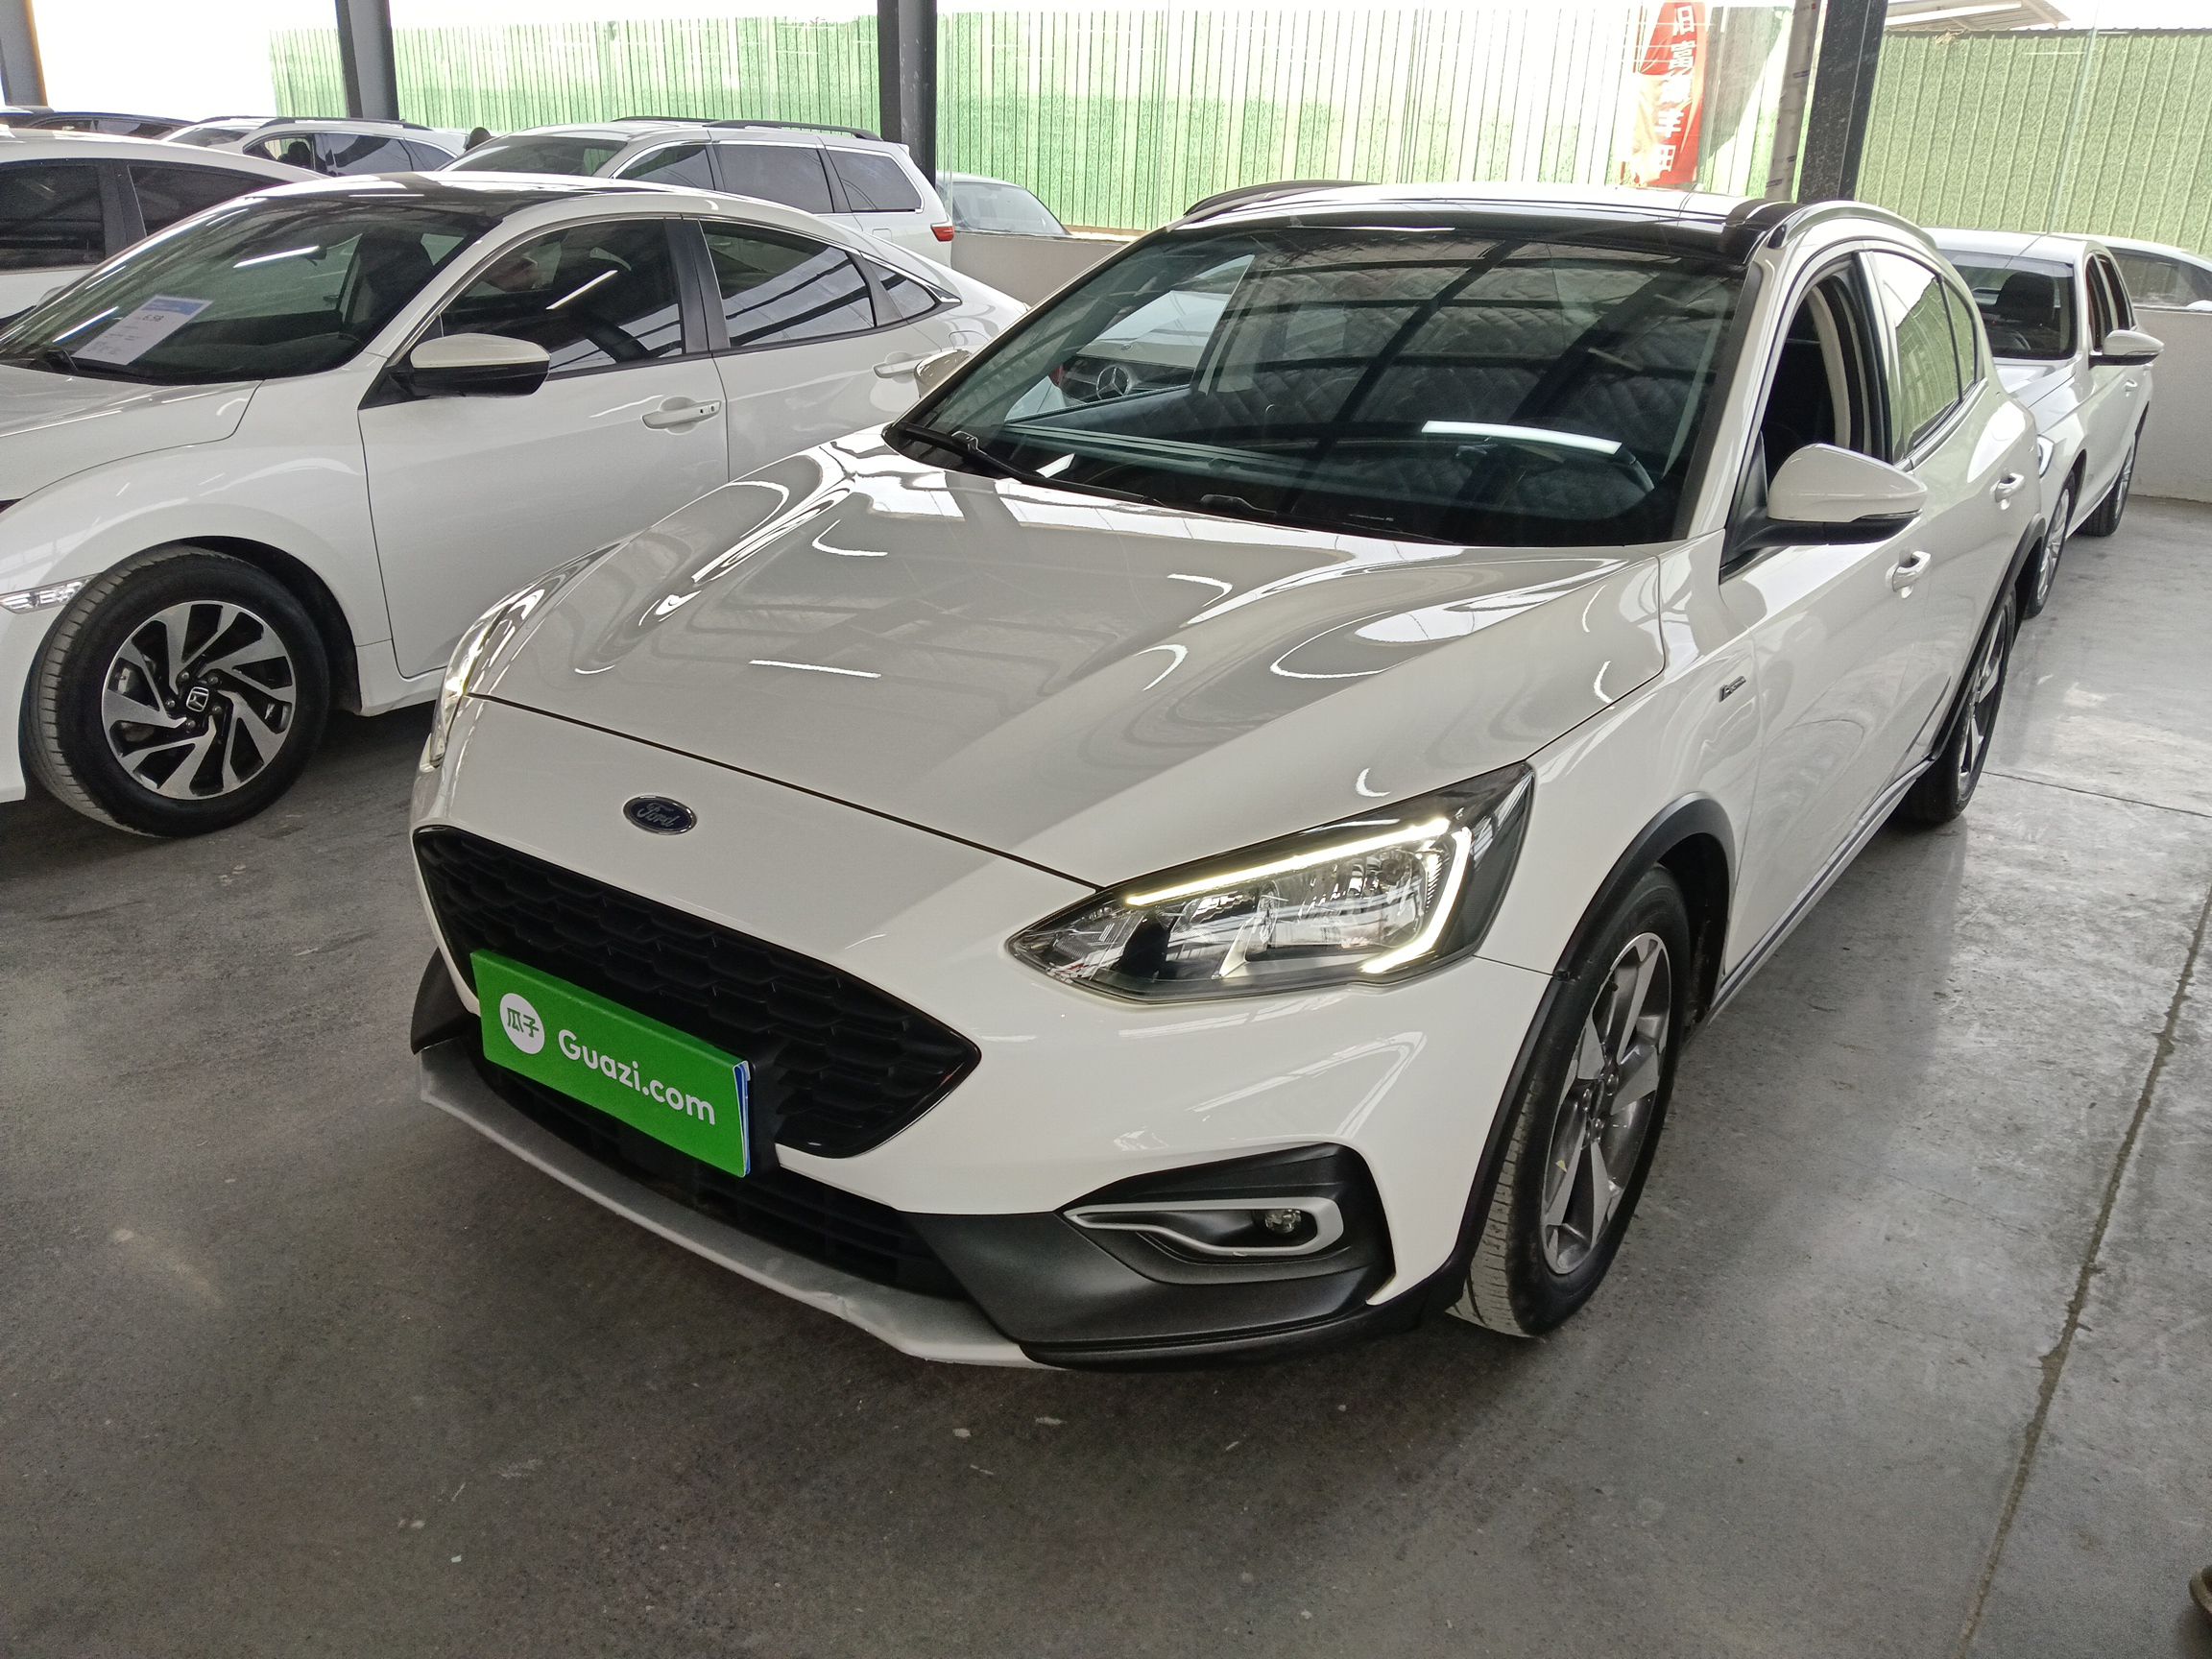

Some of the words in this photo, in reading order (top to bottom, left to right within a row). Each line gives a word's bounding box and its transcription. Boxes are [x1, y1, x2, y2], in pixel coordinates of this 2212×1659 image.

[637, 802, 681, 827] Ford
[506, 1007, 540, 1038] 瓜子
[558, 1028, 716, 1126] Guazi.com
